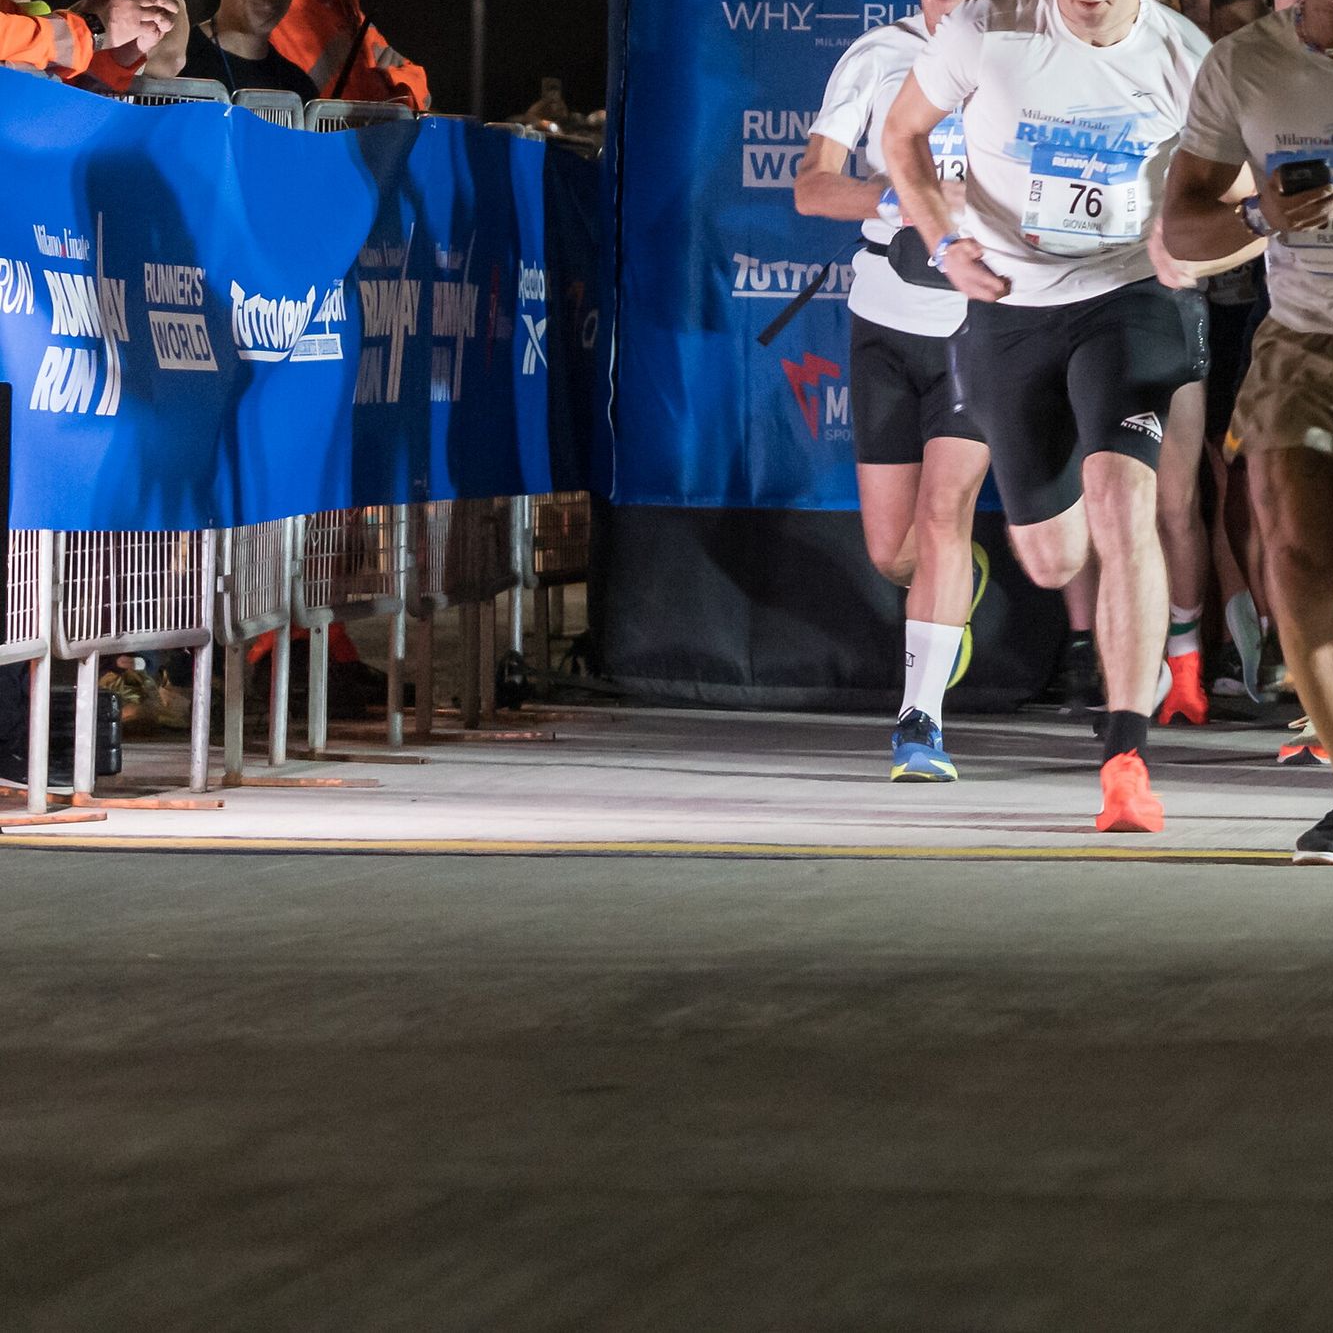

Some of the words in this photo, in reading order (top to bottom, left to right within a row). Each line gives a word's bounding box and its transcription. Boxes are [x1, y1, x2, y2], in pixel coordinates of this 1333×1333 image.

[814, 38, 856, 48] MILAN
[1069, 183, 1104, 218] 76
[151, 321, 213, 362] WORLD
[28, 346, 98, 414] RUN
